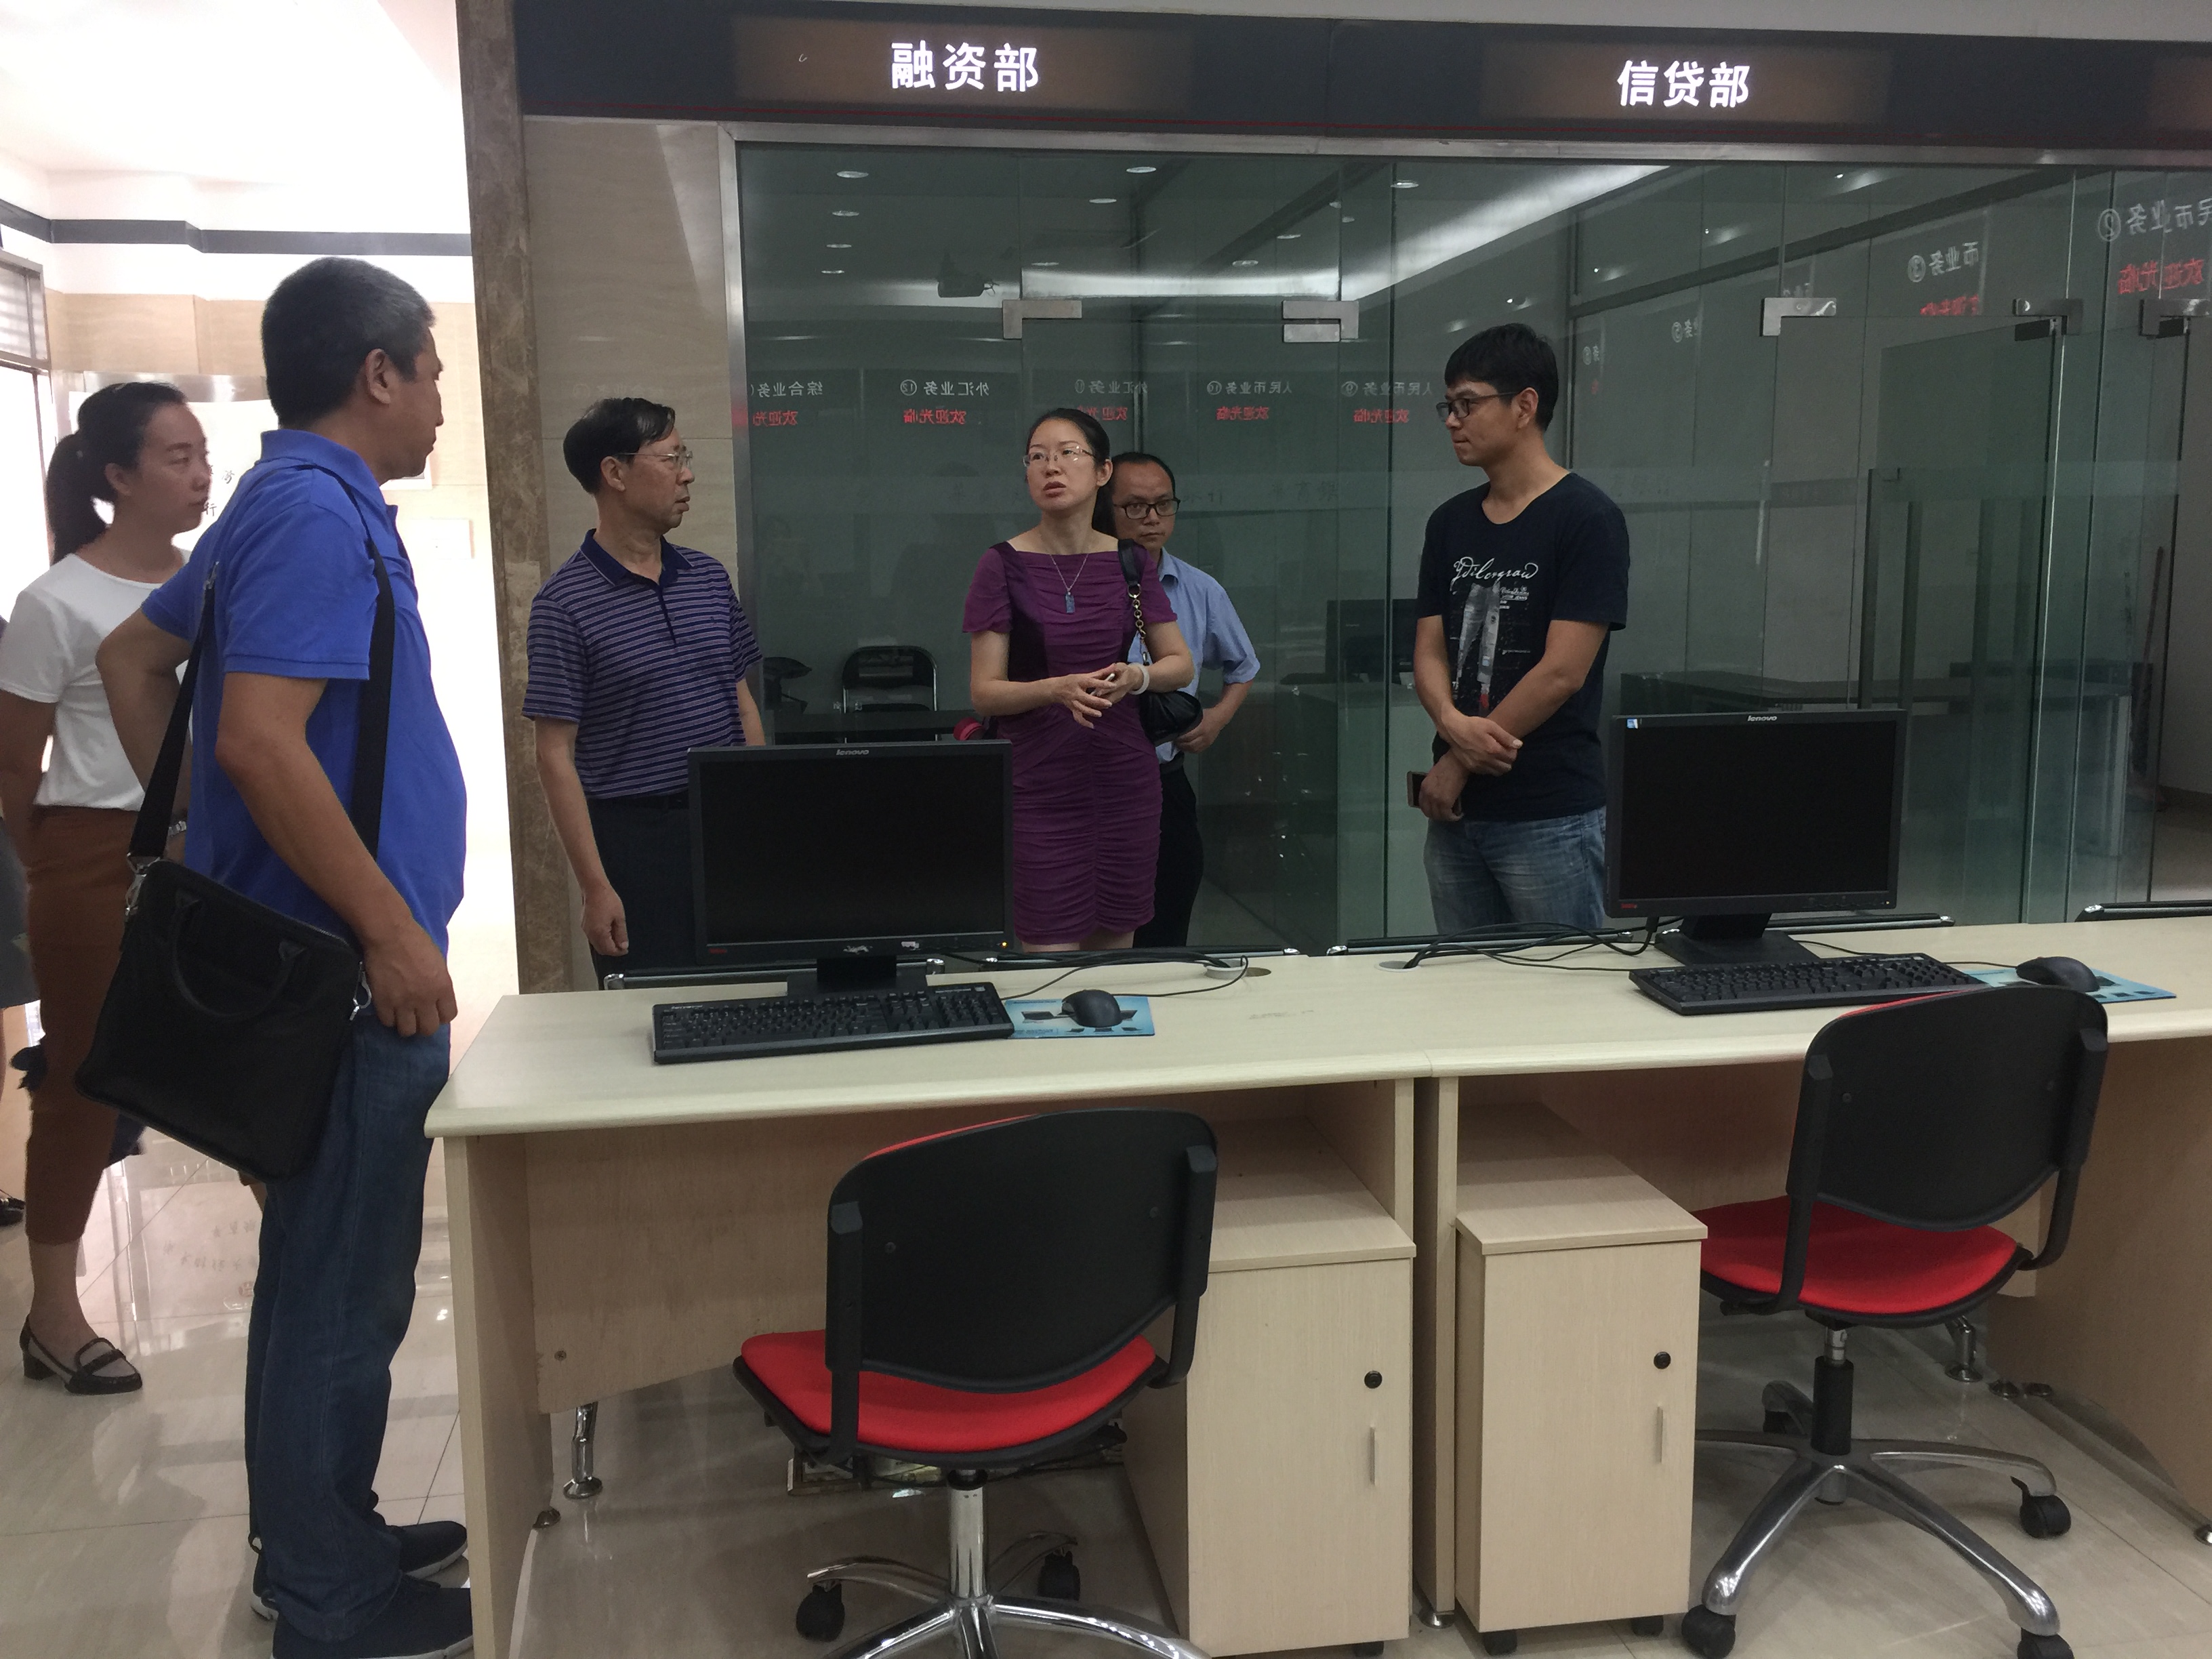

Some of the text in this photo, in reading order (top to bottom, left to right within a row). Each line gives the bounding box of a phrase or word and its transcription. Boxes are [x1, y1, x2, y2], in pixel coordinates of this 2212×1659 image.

[891, 40, 1039, 92] 融资部
[1617, 60, 1750, 108] 信贷部
